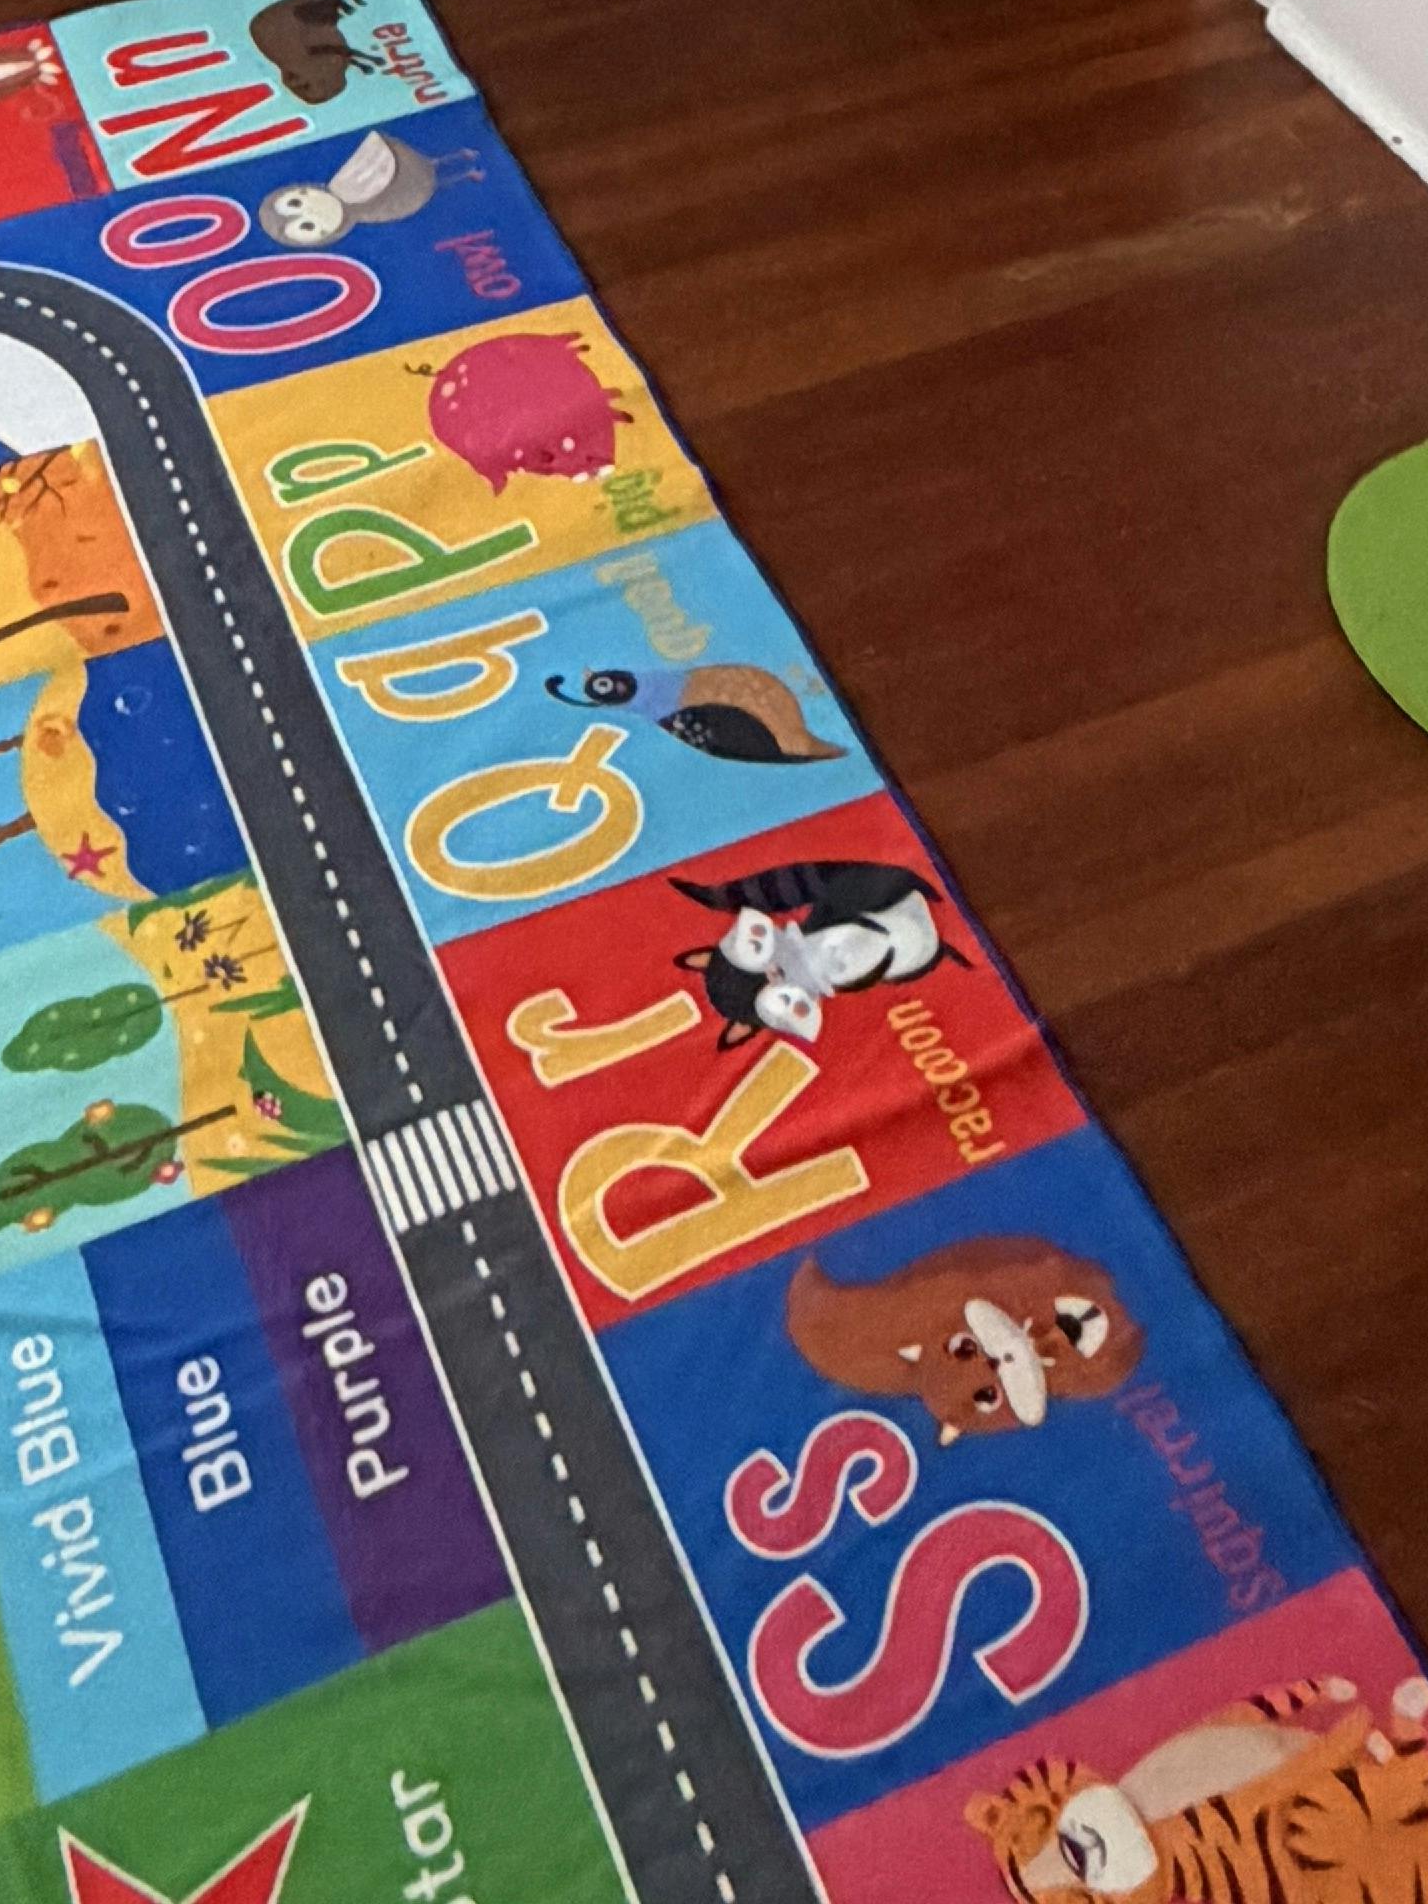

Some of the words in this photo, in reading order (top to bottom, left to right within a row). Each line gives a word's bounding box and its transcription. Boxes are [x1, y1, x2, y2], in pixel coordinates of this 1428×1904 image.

[373, 21, 447, 106] nutria
[434, 229, 521, 300] owl
[596, 468, 682, 533] pig
[886, 999, 1009, 1164] raccoon
[10, 1332, 80, 1484] Blue
[178, 1353, 254, 1514] Blue
[303, 1269, 411, 1500] Purple
[1112, 1383, 1292, 1612] squirrel
[34, 1498, 122, 1690] Vivid
[391, 1769, 475, 1904] tar
